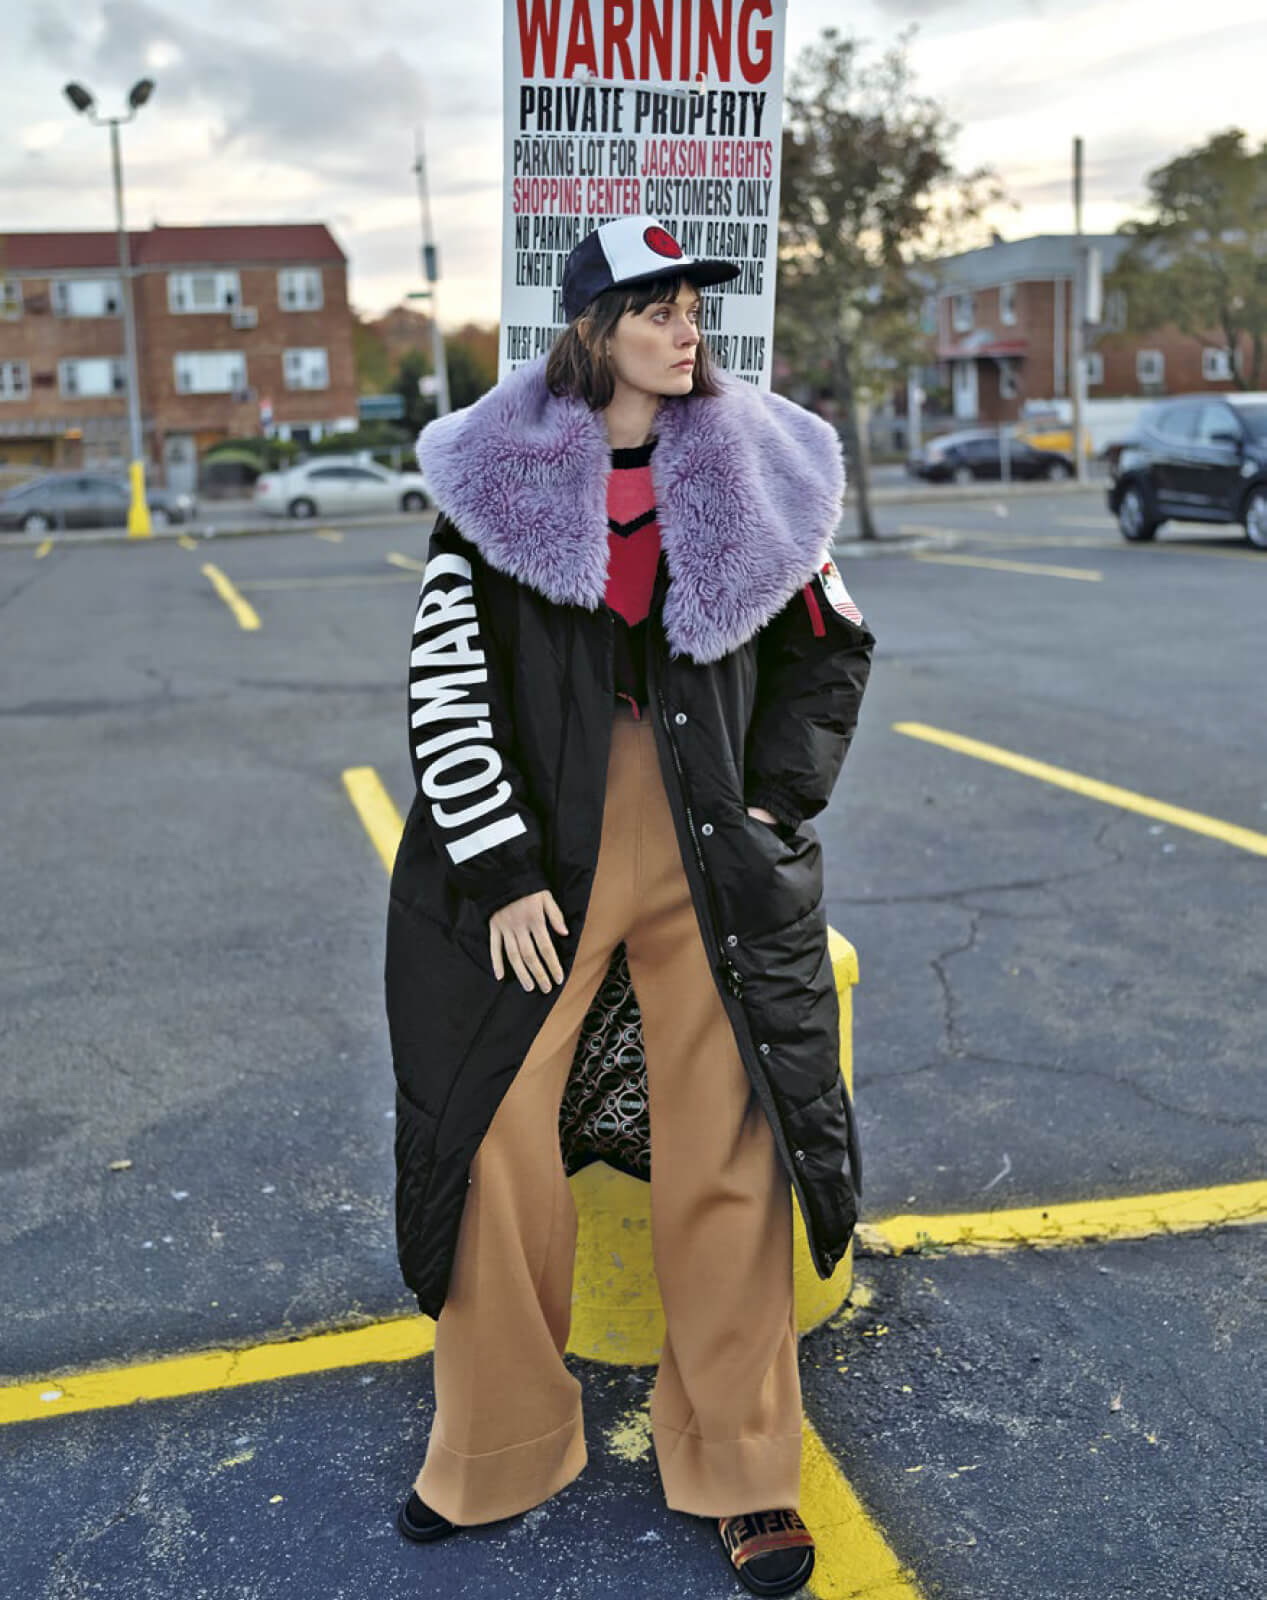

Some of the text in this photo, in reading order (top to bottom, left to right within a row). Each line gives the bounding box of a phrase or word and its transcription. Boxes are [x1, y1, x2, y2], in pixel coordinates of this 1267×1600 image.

[517, 0, 773, 84] WARNING
[520, 84, 767, 137] PRIVATE PROPERTY
[513, 139, 773, 179] PARKING LOT FOR JACKSON HEIGHTS
[513, 177, 773, 217] SHOPPING CENTER CUSTOMERS ONLY
[533, 216, 580, 252] PARKING
[681, 220, 703, 256] ANY
[706, 221, 749, 258] REASON
[752, 223, 768, 258] OR
[516, 251, 553, 287] LENGTH
[507, 325, 532, 360] THESE
[740, 335, 766, 372] DAYS
